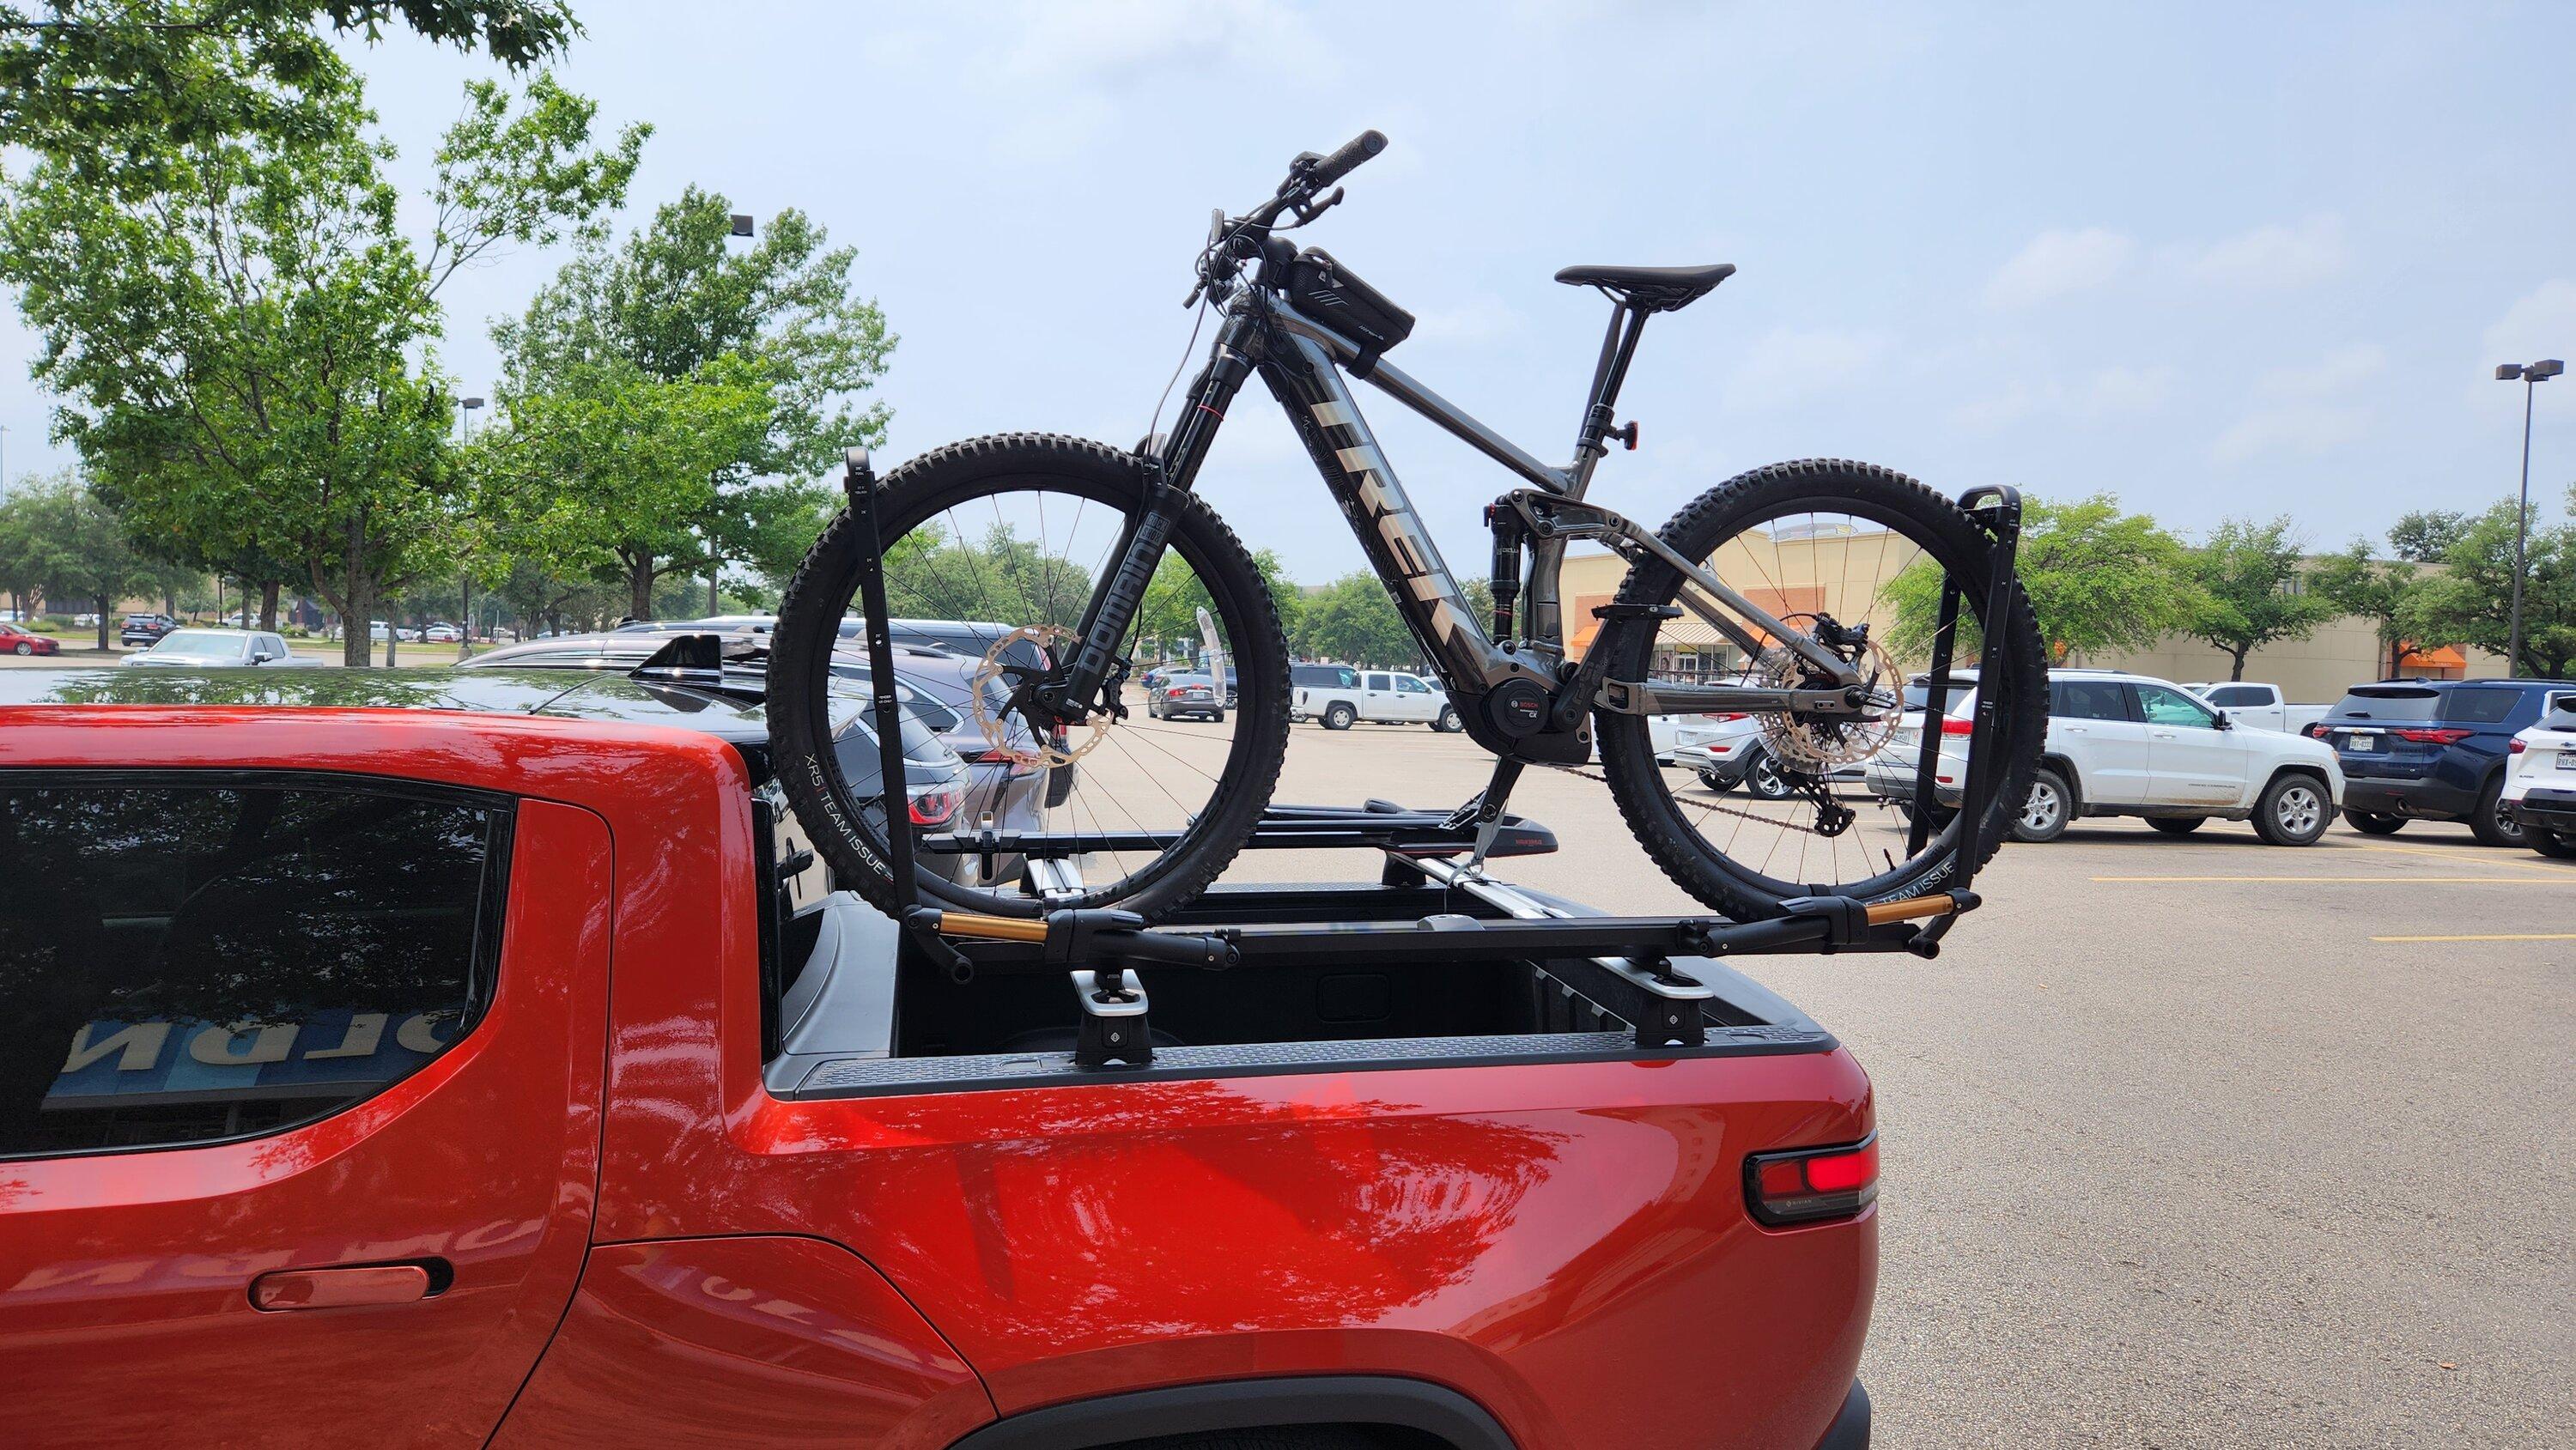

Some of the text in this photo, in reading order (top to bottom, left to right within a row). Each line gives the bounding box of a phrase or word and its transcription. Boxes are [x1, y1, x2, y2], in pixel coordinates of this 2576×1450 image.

[1145, 515, 1169, 531] ROCK
[1310, 378, 1481, 646] TREK
[1078, 542, 1157, 675] DOMAIN
[821, 792, 852, 836] TEAM
[848, 834, 886, 874] ISSUE
[1919, 861, 1954, 890] ISSUE
